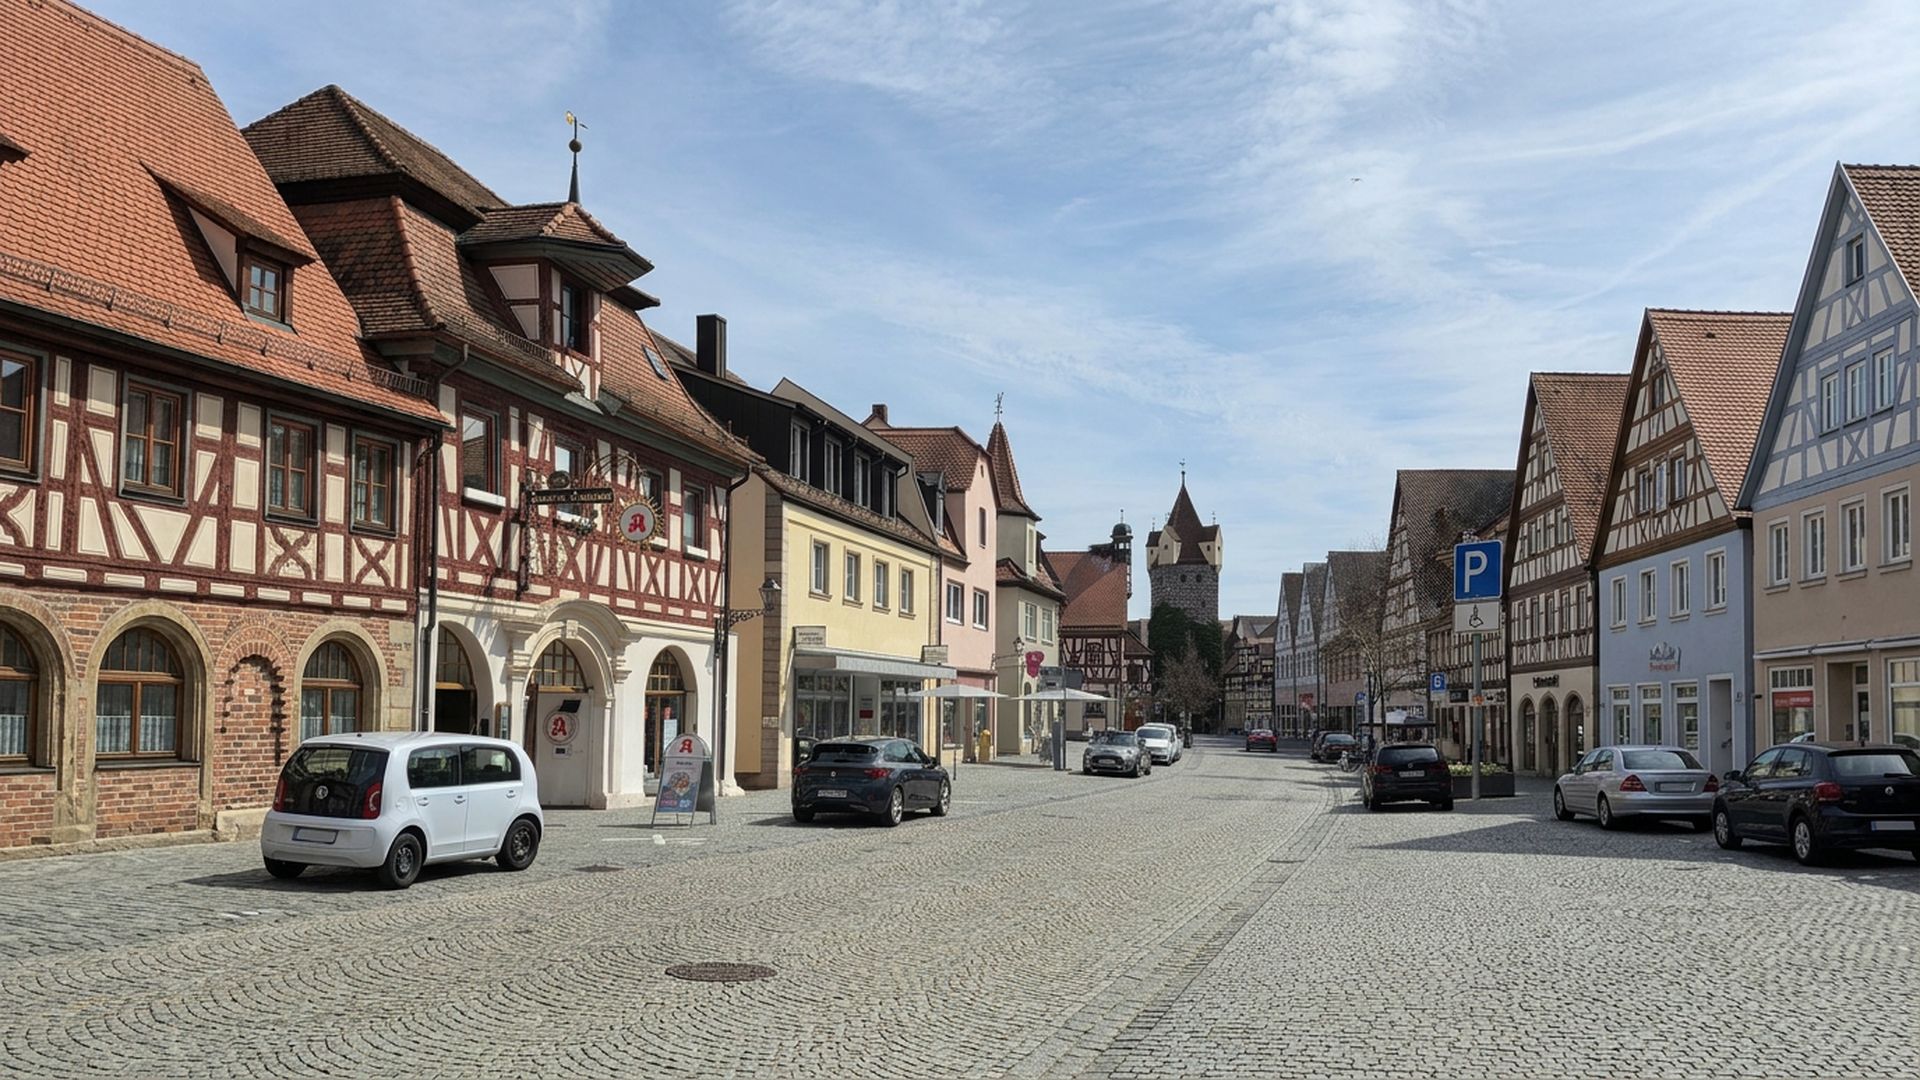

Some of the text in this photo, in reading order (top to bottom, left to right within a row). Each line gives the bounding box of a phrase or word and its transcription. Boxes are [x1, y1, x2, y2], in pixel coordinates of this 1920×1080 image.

[628, 513, 646, 533] A
[1464, 550, 1488, 593] P
[551, 716, 567, 737] A
[679, 738, 693, 754] A
